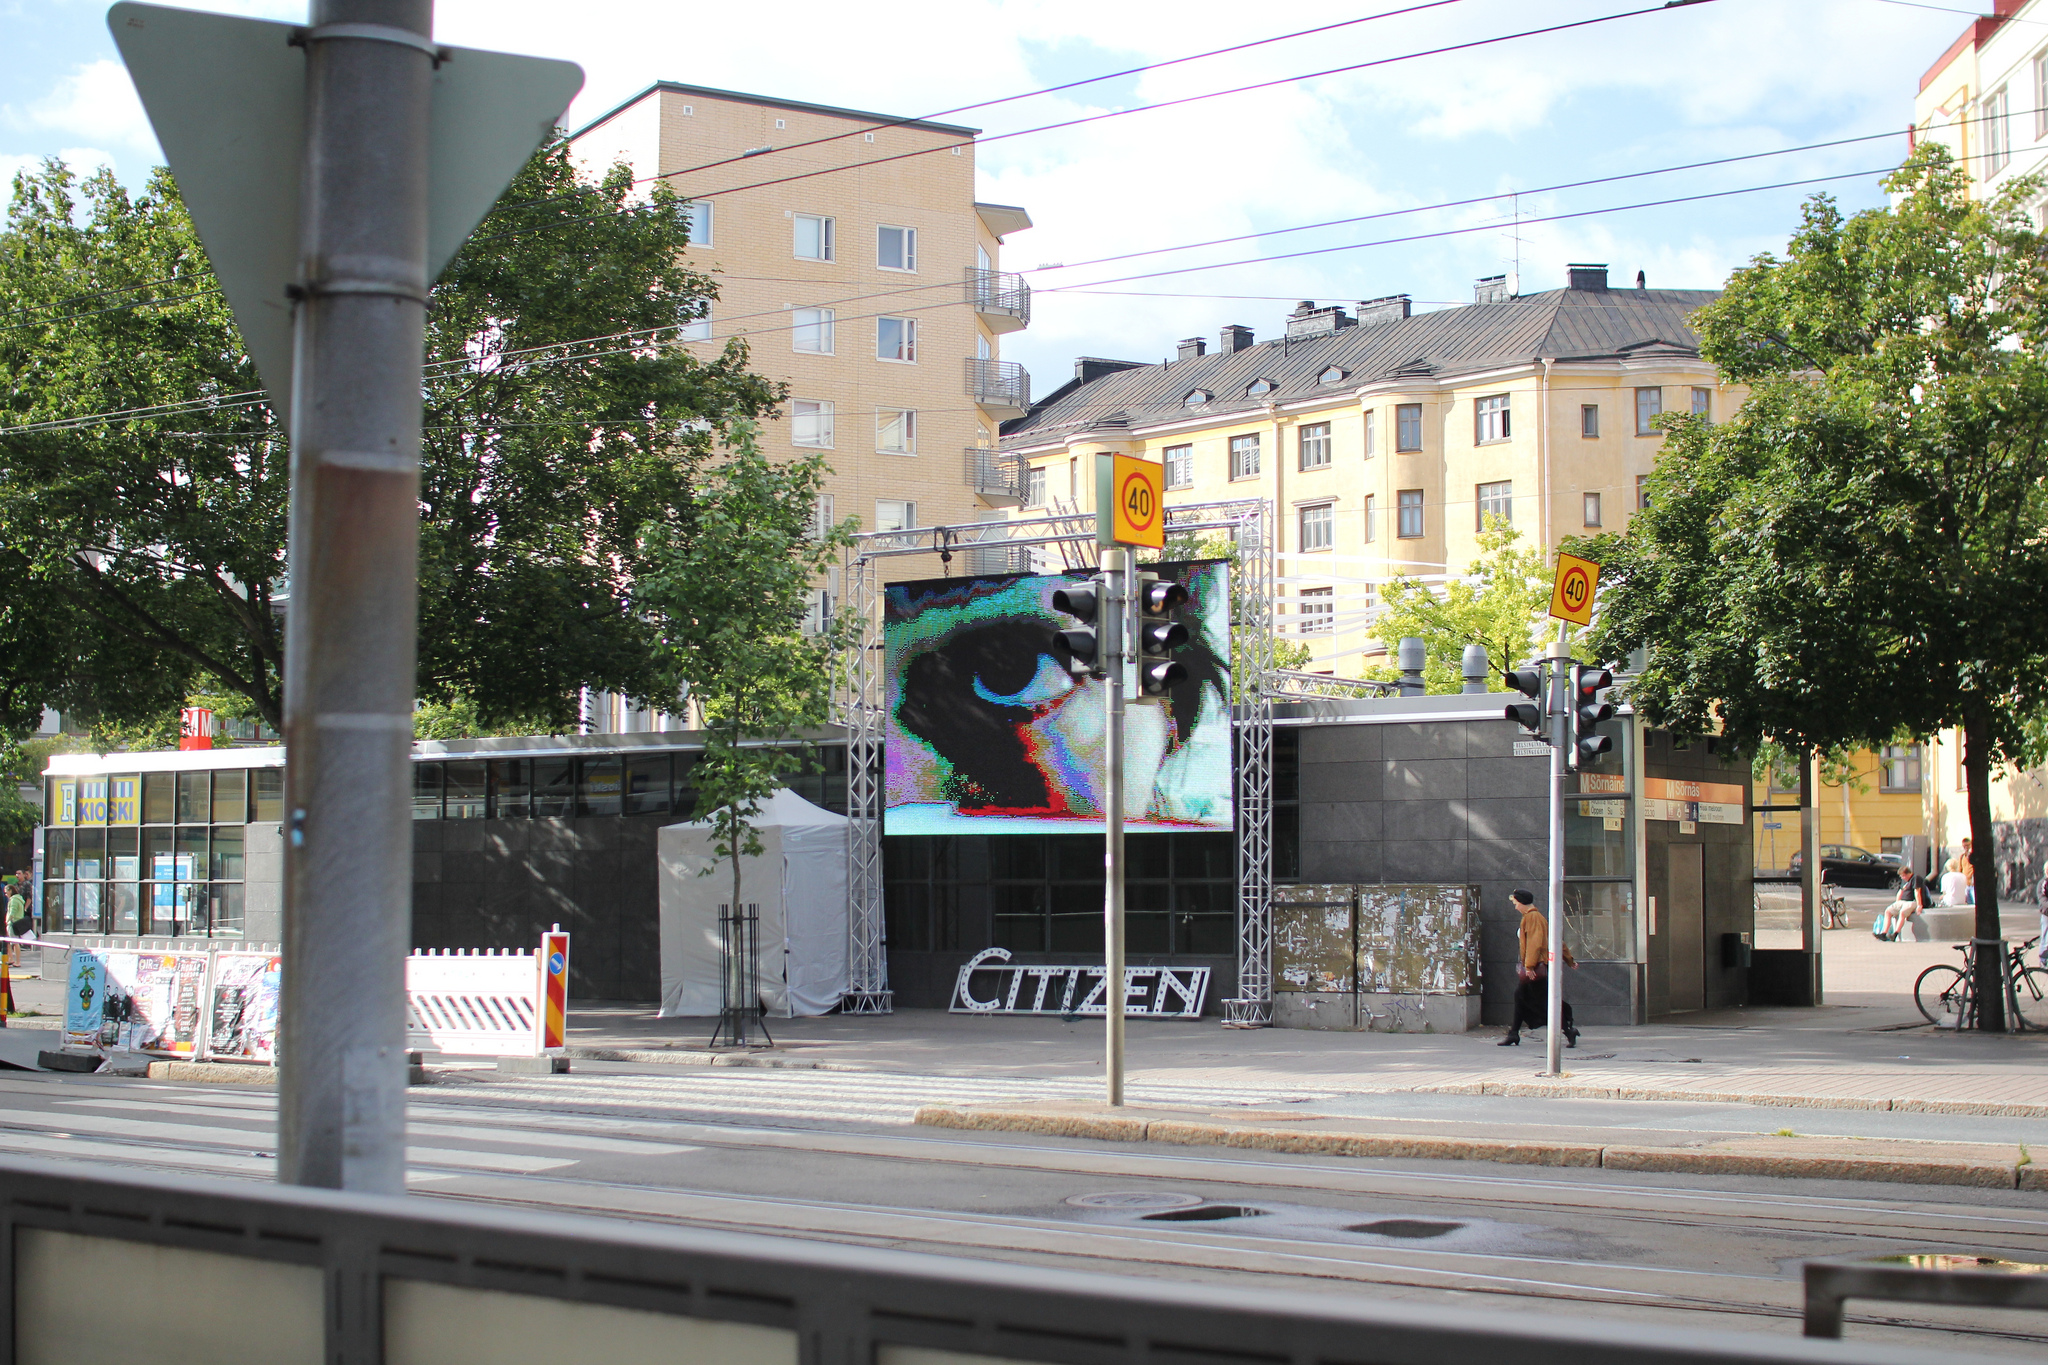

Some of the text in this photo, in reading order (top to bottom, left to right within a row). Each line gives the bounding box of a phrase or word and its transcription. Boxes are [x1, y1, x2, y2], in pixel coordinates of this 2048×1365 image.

[1128, 487, 1149, 516] 40
[1566, 578, 1584, 601] 40
[201, 711, 212, 737] M
[1580, 773, 1590, 793] M
[1666, 780, 1700, 798] M Sörnäs
[79, 801, 133, 822] KIOSKI
[960, 947, 1203, 1016] CITIZEN
